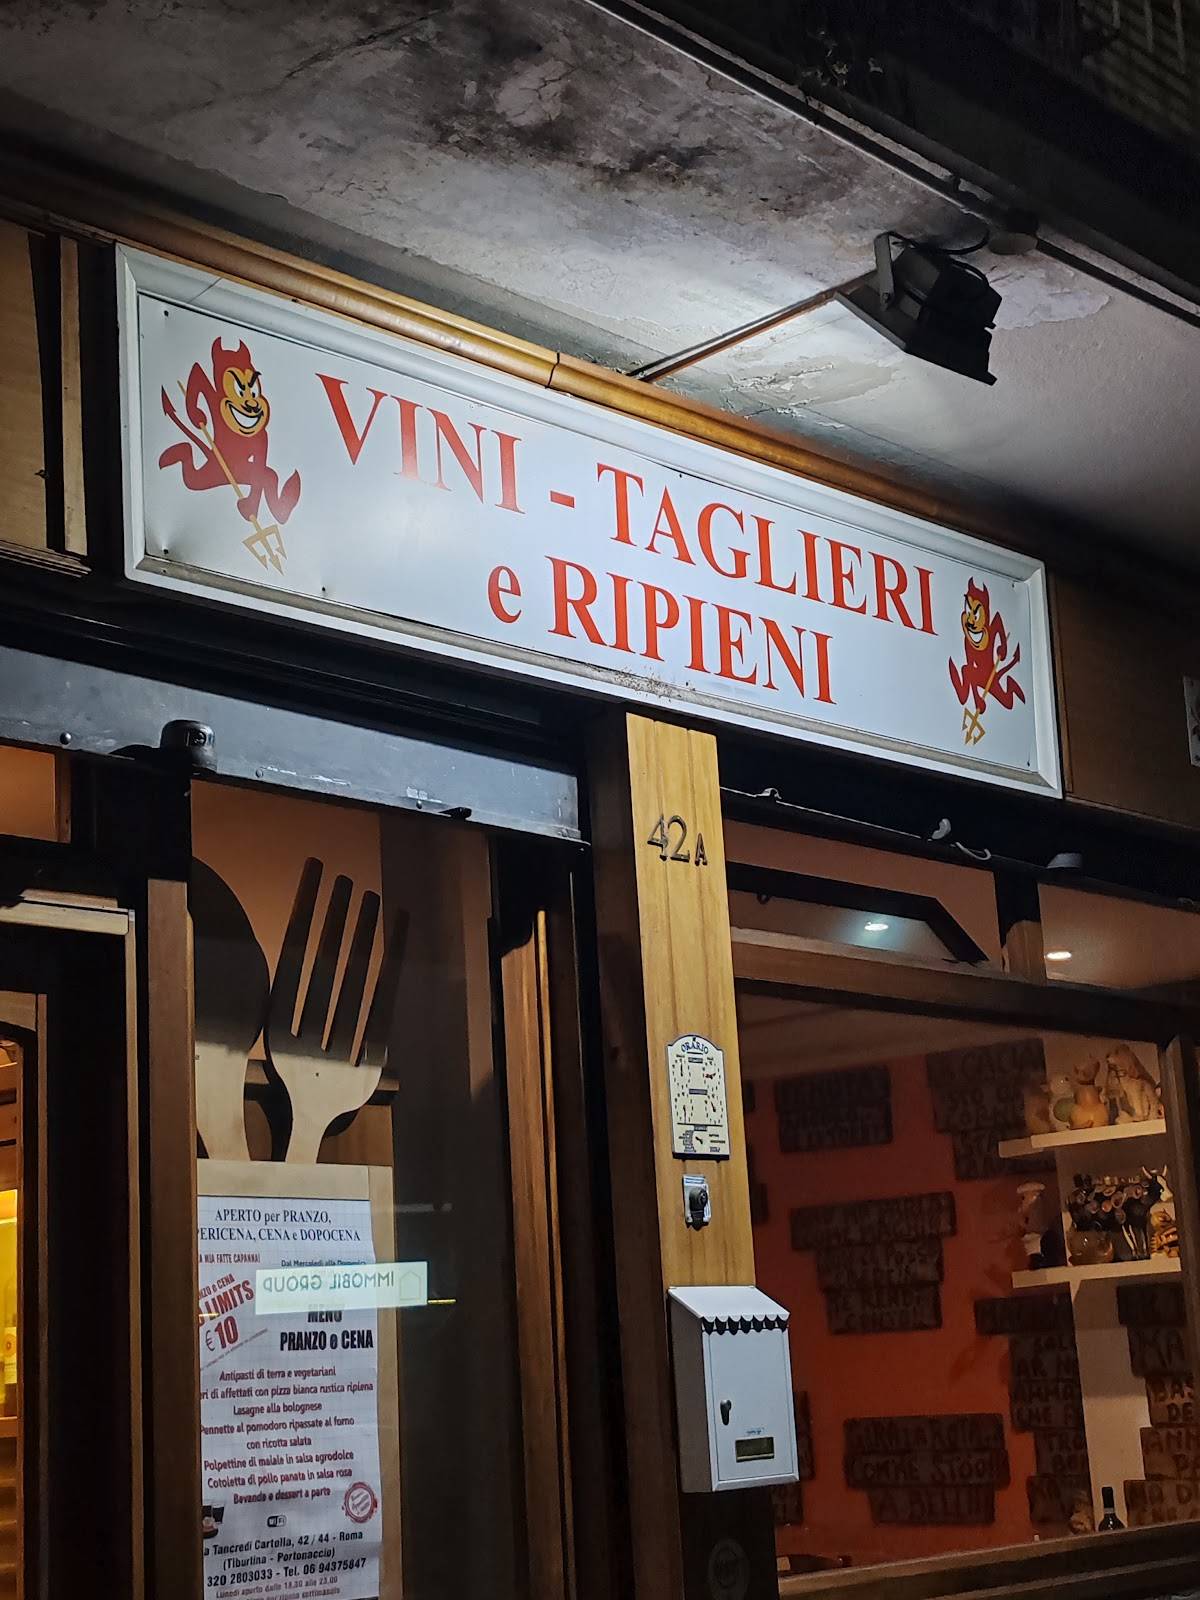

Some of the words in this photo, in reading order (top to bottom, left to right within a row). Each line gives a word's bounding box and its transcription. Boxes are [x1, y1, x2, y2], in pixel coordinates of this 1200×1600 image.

[315, 372, 525, 514] VINI
[550, 490, 575, 508] -
[597, 463, 939, 636] TAGLIERI
[487, 565, 521, 623] e
[544, 555, 837, 705] RIPIENI
[681, 1041, 709, 1054] ORARIO
[215, 1209, 261, 1222] APERTO
[264, 1213, 280, 1225] per
[283, 1210, 331, 1223] PRANZO,
[199, 1228, 256, 1241] ERICENA,
[258, 1228, 290, 1241] CENA
[292, 1231, 297, 1241] e
[300, 1229, 361, 1241] DOPOCENA
[216, 1254, 232, 1263] FATTE
[217, 1273, 235, 1289] CENA
[205, 1280, 254, 1320] LIMITS
[280, 1331, 326, 1351] PRANZO
[341, 1330, 374, 1349] CENA
[219, 1369, 255, 1383] Antipasti
[256, 1369, 264, 1379] di
[267, 1369, 286, 1379] terra
[288, 1370, 292, 1378] e
[294, 1366, 337, 1380] vegetariani
[211, 1388, 218, 1399] di
[221, 1387, 253, 1398] affettati
[255, 1389, 268, 1397] con
[271, 1385, 291, 1399] pizza
[293, 1384, 318, 1395] bianca
[320, 1382, 344, 1393] rustica
[346, 1381, 374, 1394] ripiena
[234, 1405, 264, 1417] Lasagne
[267, 1403, 280, 1413] alla
[282, 1402, 322, 1415] bolognese
[236, 1422, 244, 1433] al
[246, 1420, 287, 1435] pomodoro
[289, 1419, 323, 1431] ripassate
[325, 1416, 332, 1427] al
[334, 1416, 354, 1426] forno
[246, 1441, 260, 1450] con
[262, 1438, 288, 1449] ricotta
[290, 1436, 312, 1447] salata
[204, 1458, 246, 1472] Polpettine
[248, 1456, 256, 1467] di
[258, 1454, 284, 1467] maiale
[286, 1454, 294, 1464] in
[296, 1453, 313, 1464] salsa
[316, 1450, 354, 1465] agrodolce
[208, 1476, 246, 1489] Cotoletta
[248, 1474, 256, 1485] di
[258, 1472, 278, 1486] pollo
[280, 1472, 306, 1485] panata
[307, 1470, 315, 1480] in
[316, 1468, 334, 1479] salsa
[336, 1468, 352, 1478] rosa
[234, 1490, 267, 1504] Bevande
[268, 1492, 274, 1500] e
[276, 1489, 302, 1501] dessert
[304, 1490, 308, 1498] a
[311, 1487, 331, 1500] parte
[213, 1541, 252, 1555] Tancredi
[298, 1535, 310, 1546] 42
[318, 1533, 330, 1543] 44
[339, 1531, 364, 1542] Roma
[223, 1555, 267, 1571] (Tiburtina
[277, 1547, 335, 1563] Portonaccio)
[207, 1574, 226, 1587] 320
[284, 1566, 300, 1578] Tel.
[304, 1564, 316, 1575] 06
